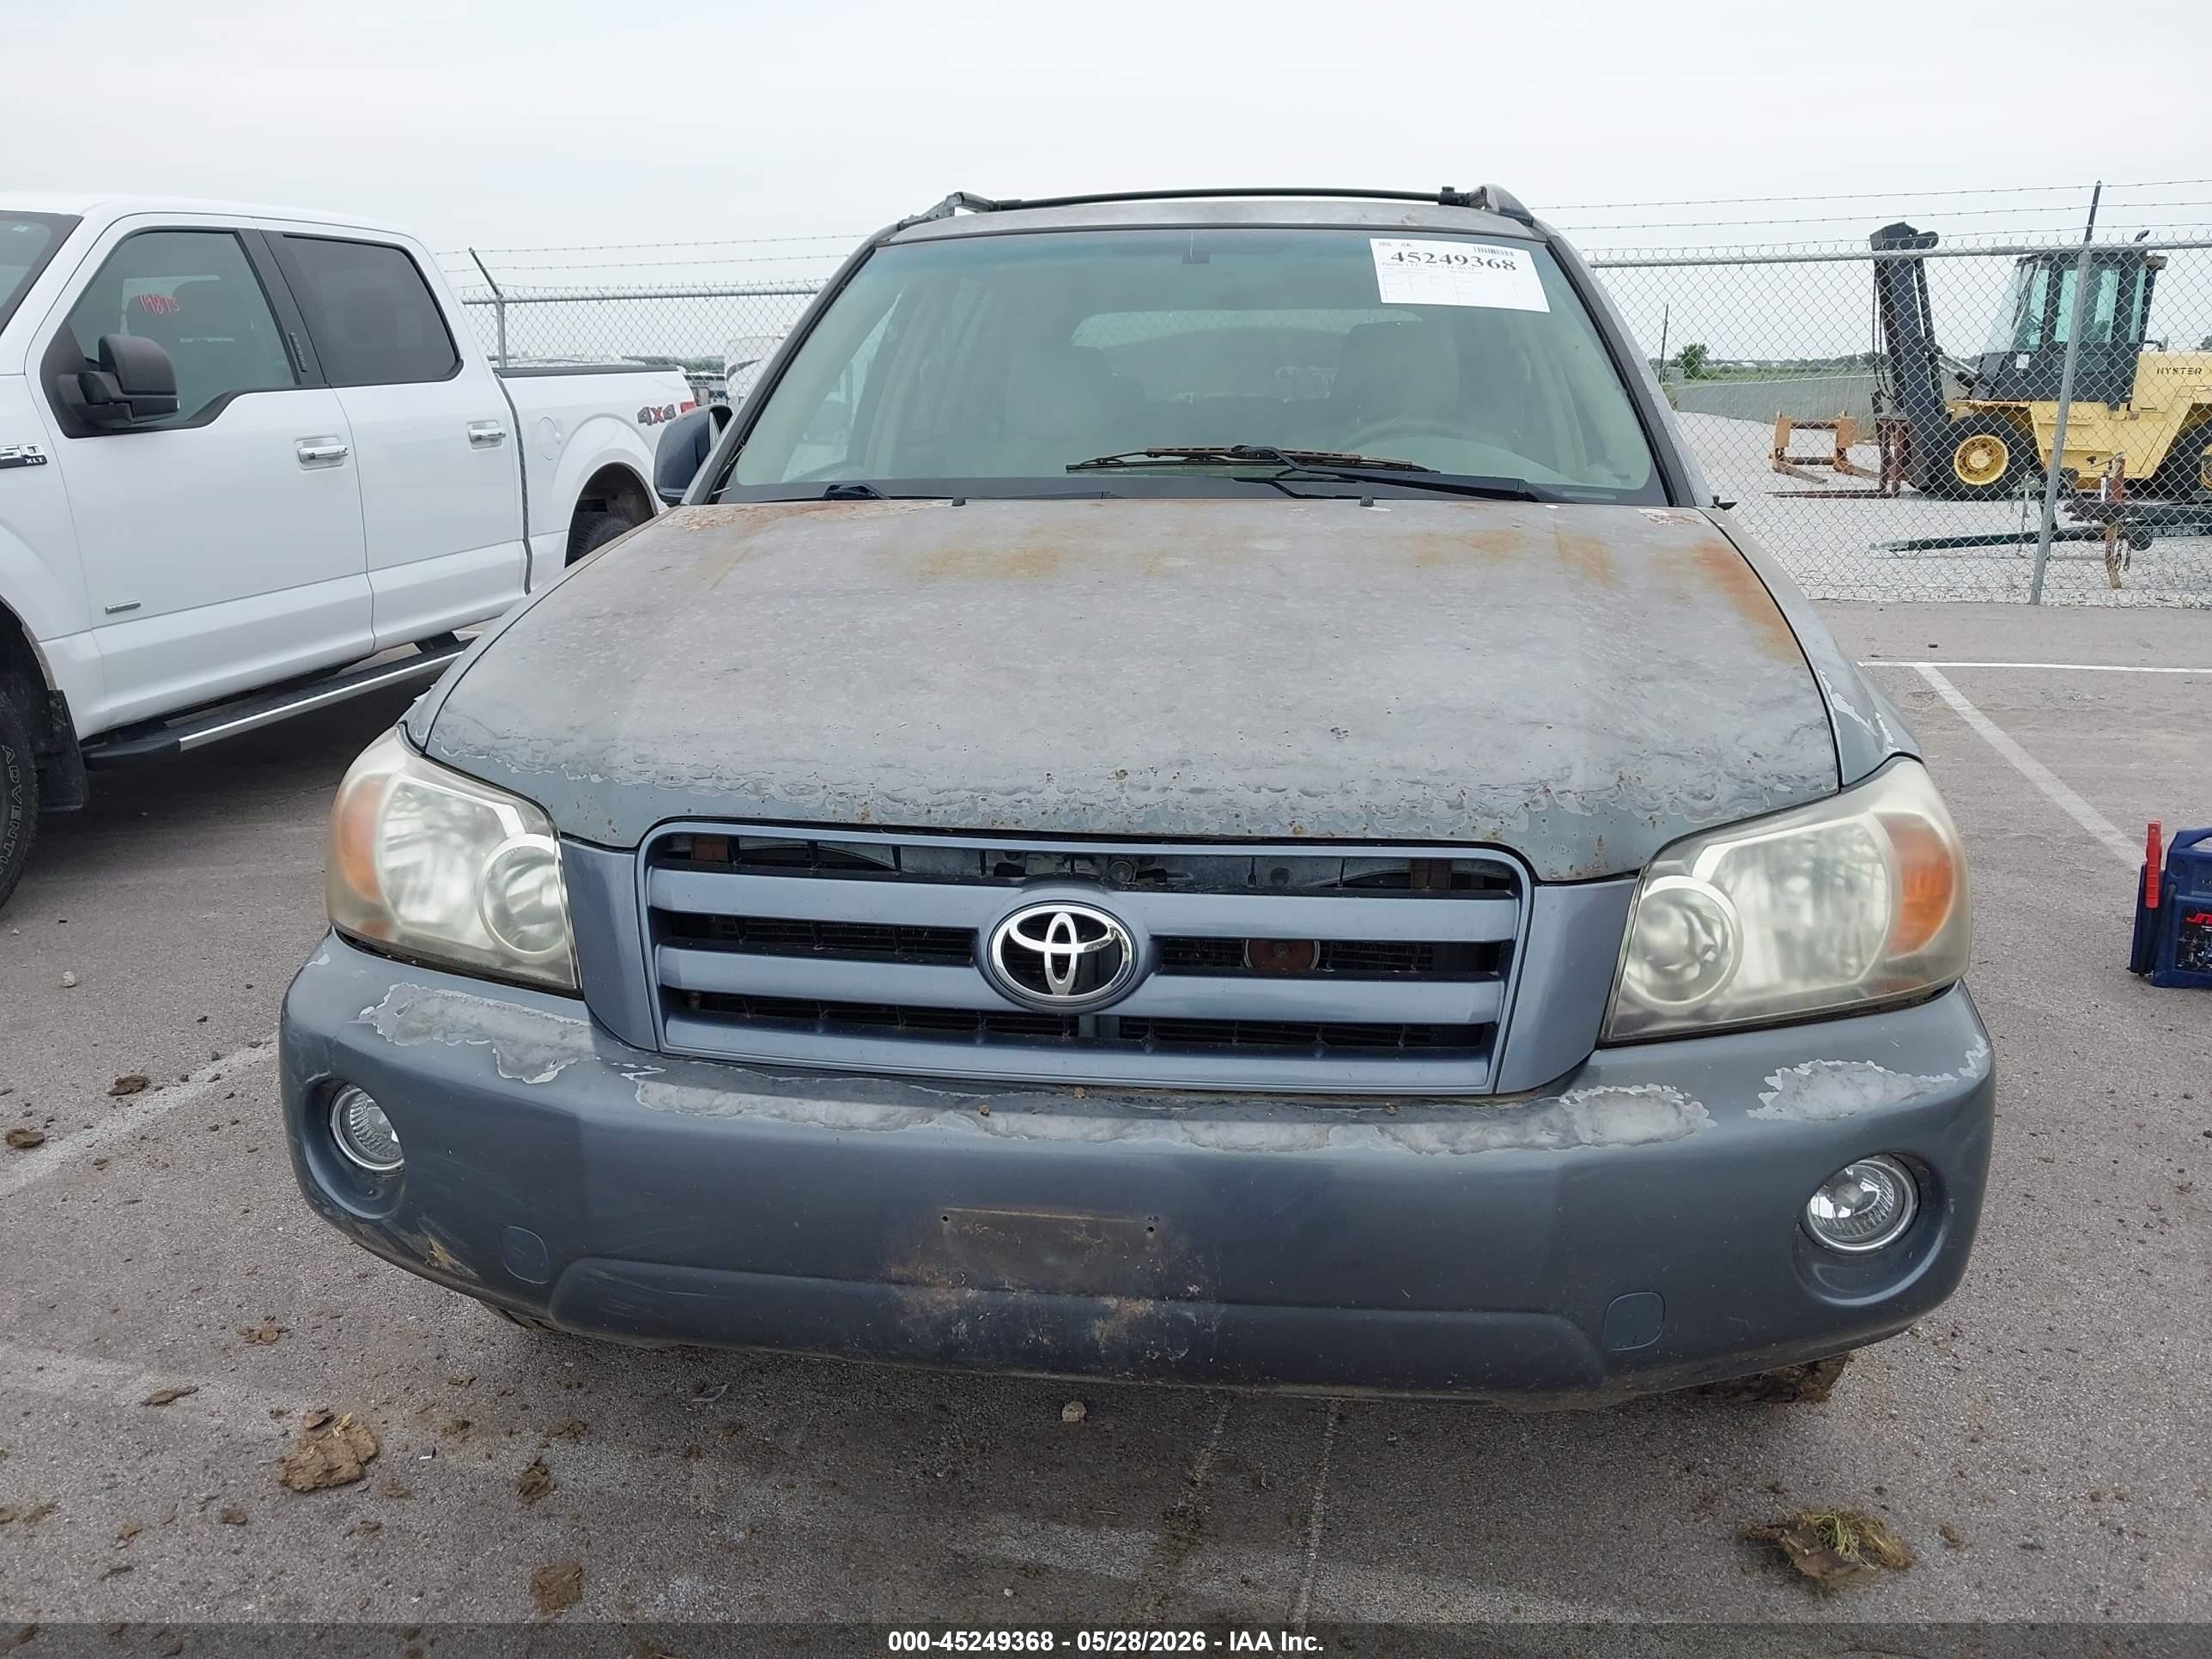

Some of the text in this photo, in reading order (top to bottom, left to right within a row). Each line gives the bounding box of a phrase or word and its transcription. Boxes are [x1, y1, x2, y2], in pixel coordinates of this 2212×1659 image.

[1390, 251, 1517, 271] 45249368
[2156, 367, 2203, 375] HYSTER
[26, 456, 44, 465] XLT
